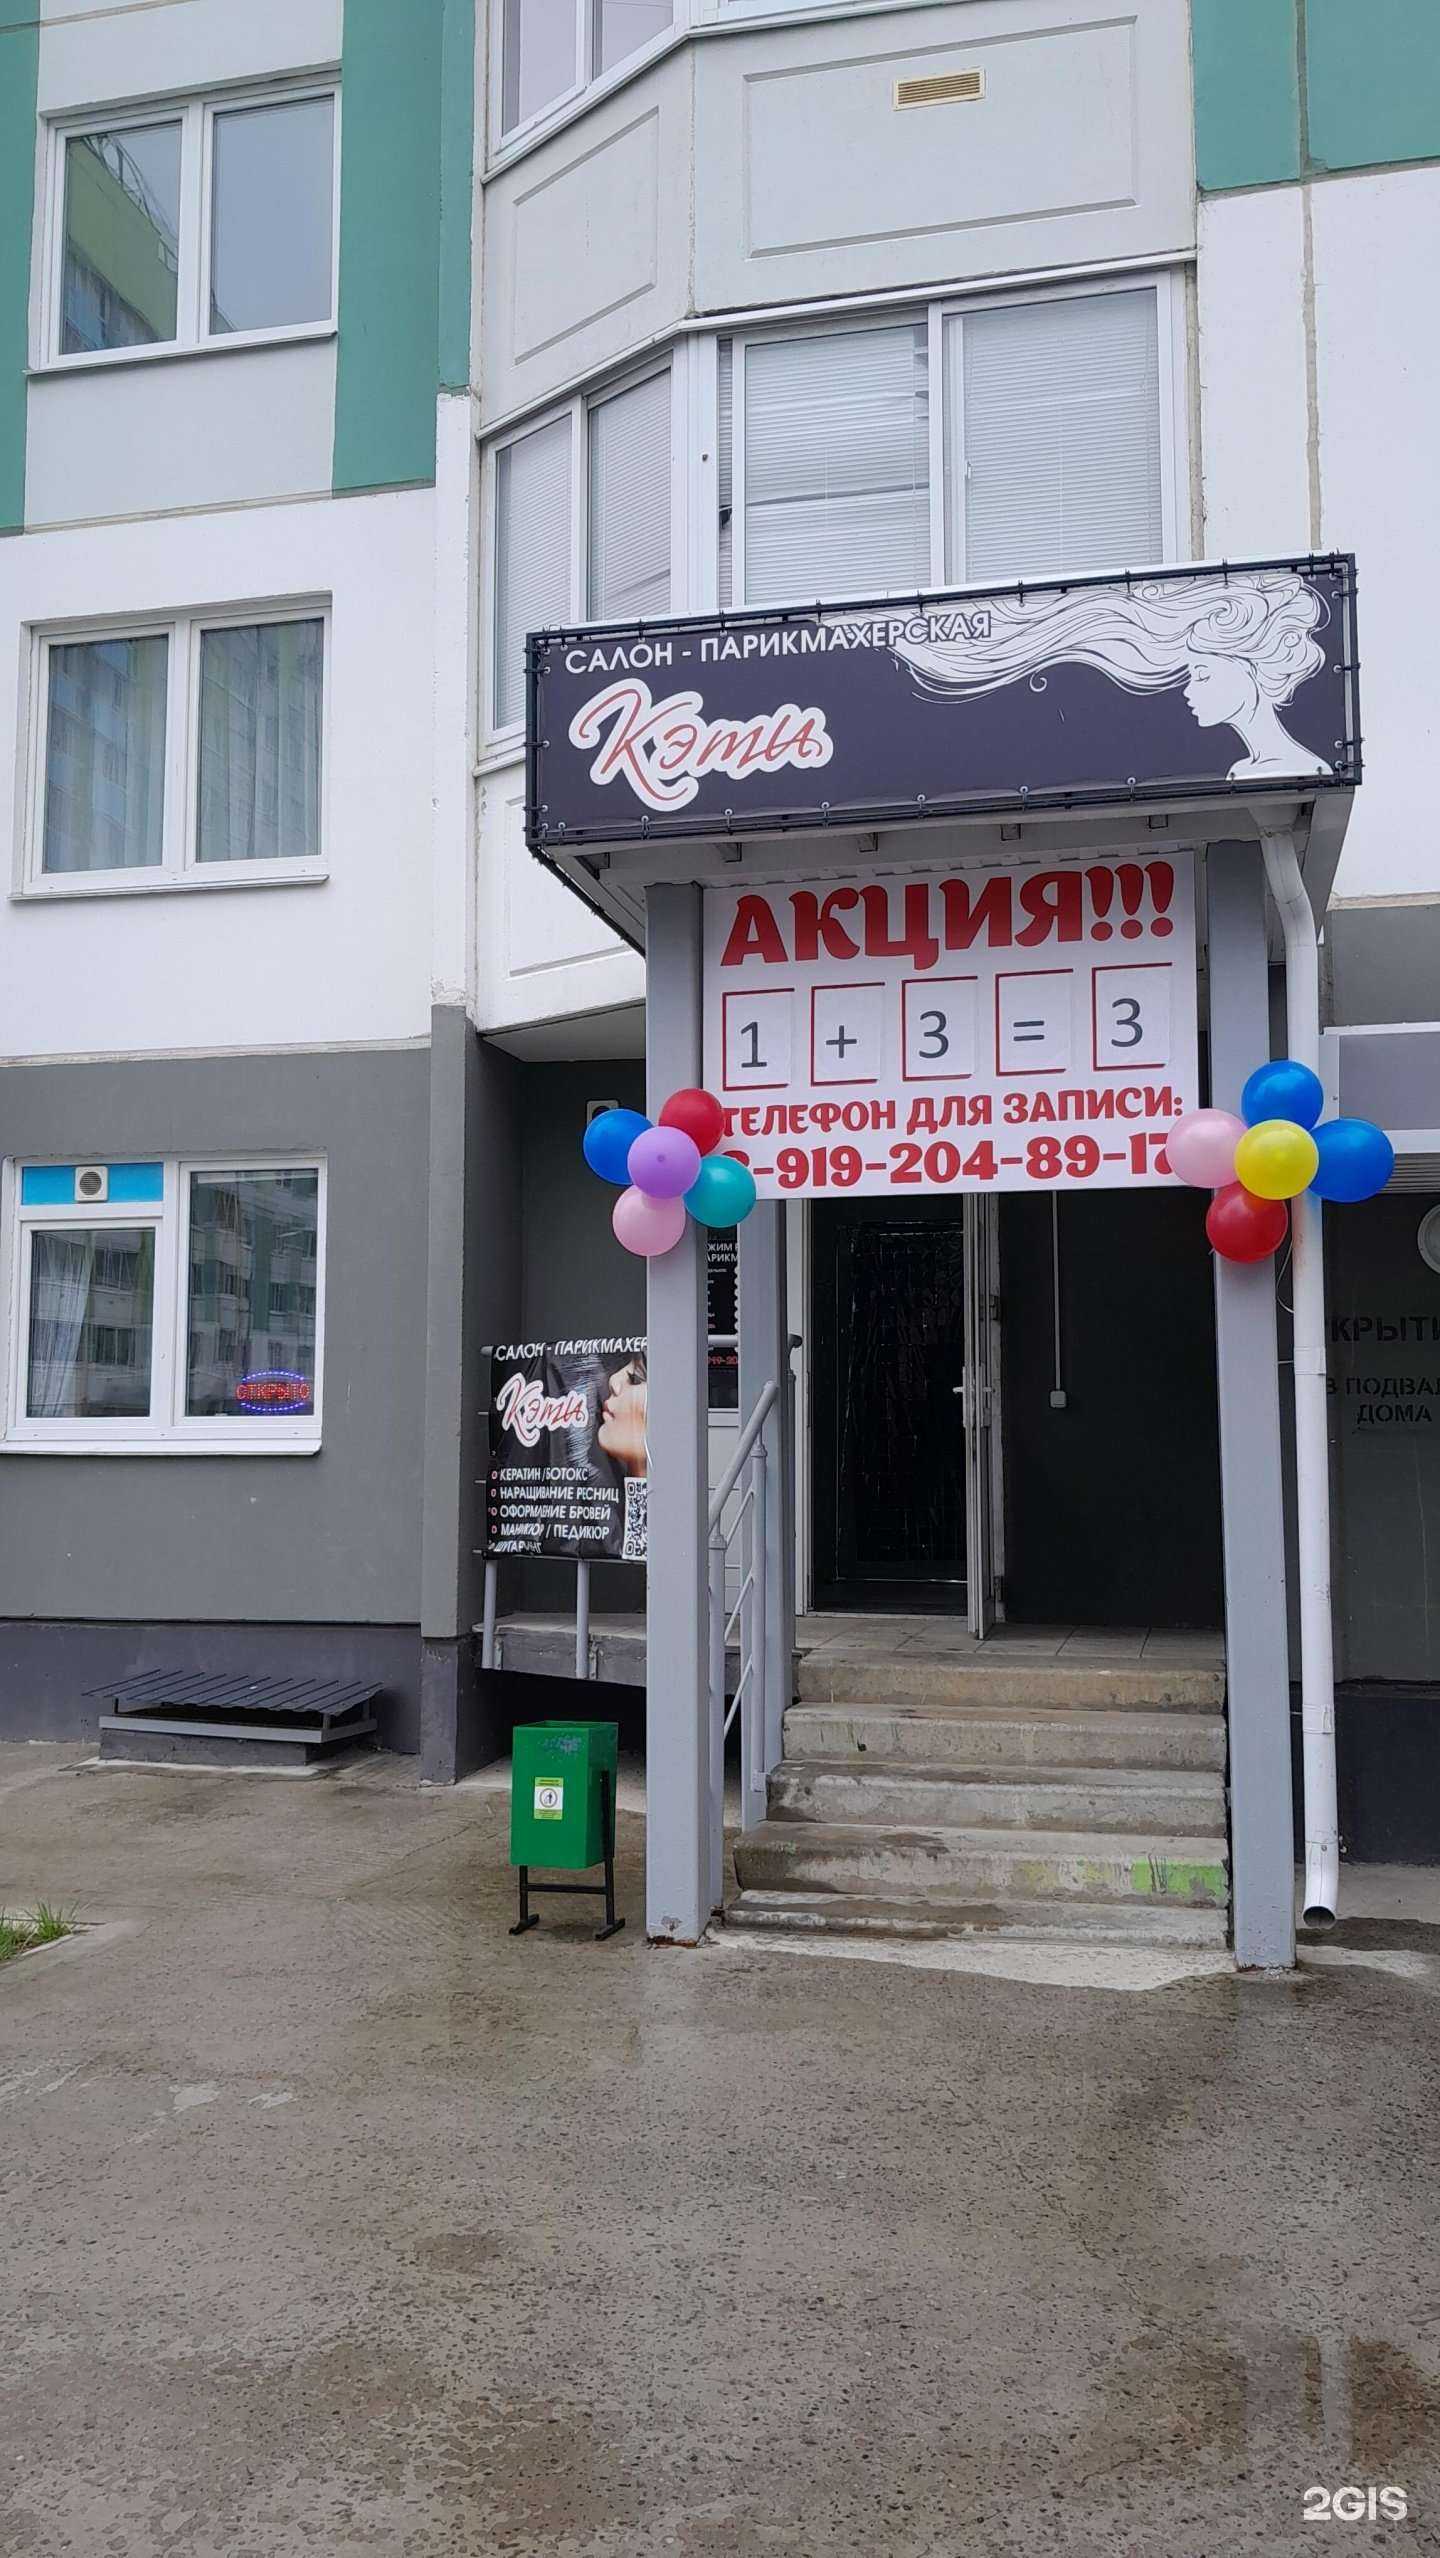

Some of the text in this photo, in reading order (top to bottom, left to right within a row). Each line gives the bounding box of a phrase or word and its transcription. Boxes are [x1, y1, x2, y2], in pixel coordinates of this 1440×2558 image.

[565, 642, 673, 674] САЛОН
[700, 611, 991, 663] ПАРИКМАХЕРСКАЯ
[573, 682, 829, 807] Кэти
[720, 861, 1175, 970] АКЦИЯ!!!
[741, 1021, 767, 1068] 1
[918, 1010, 949, 1059] 3
[1111, 998, 1143, 1048] 3
[722, 1086, 1183, 1138] ТЕЛЕФОН ДЛЯ ЗАПИСИ:
[722, 1132, 1174, 1189] -919-204-89-17
[495, 1342, 546, 1361] САЛОН
[236, 1383, 310, 1400] ОТКРЫТО
[1356, 1402, 1433, 1424] ДОМА
[500, 1467, 541, 1480] КЕРАТИН
[500, 1486, 619, 1503] НАРАЩИВАНИЕ РЕСНИЦ
[569, 1504, 611, 1520] БРОВЕЙ
[553, 1524, 610, 1540] ПЕДИКЮР
